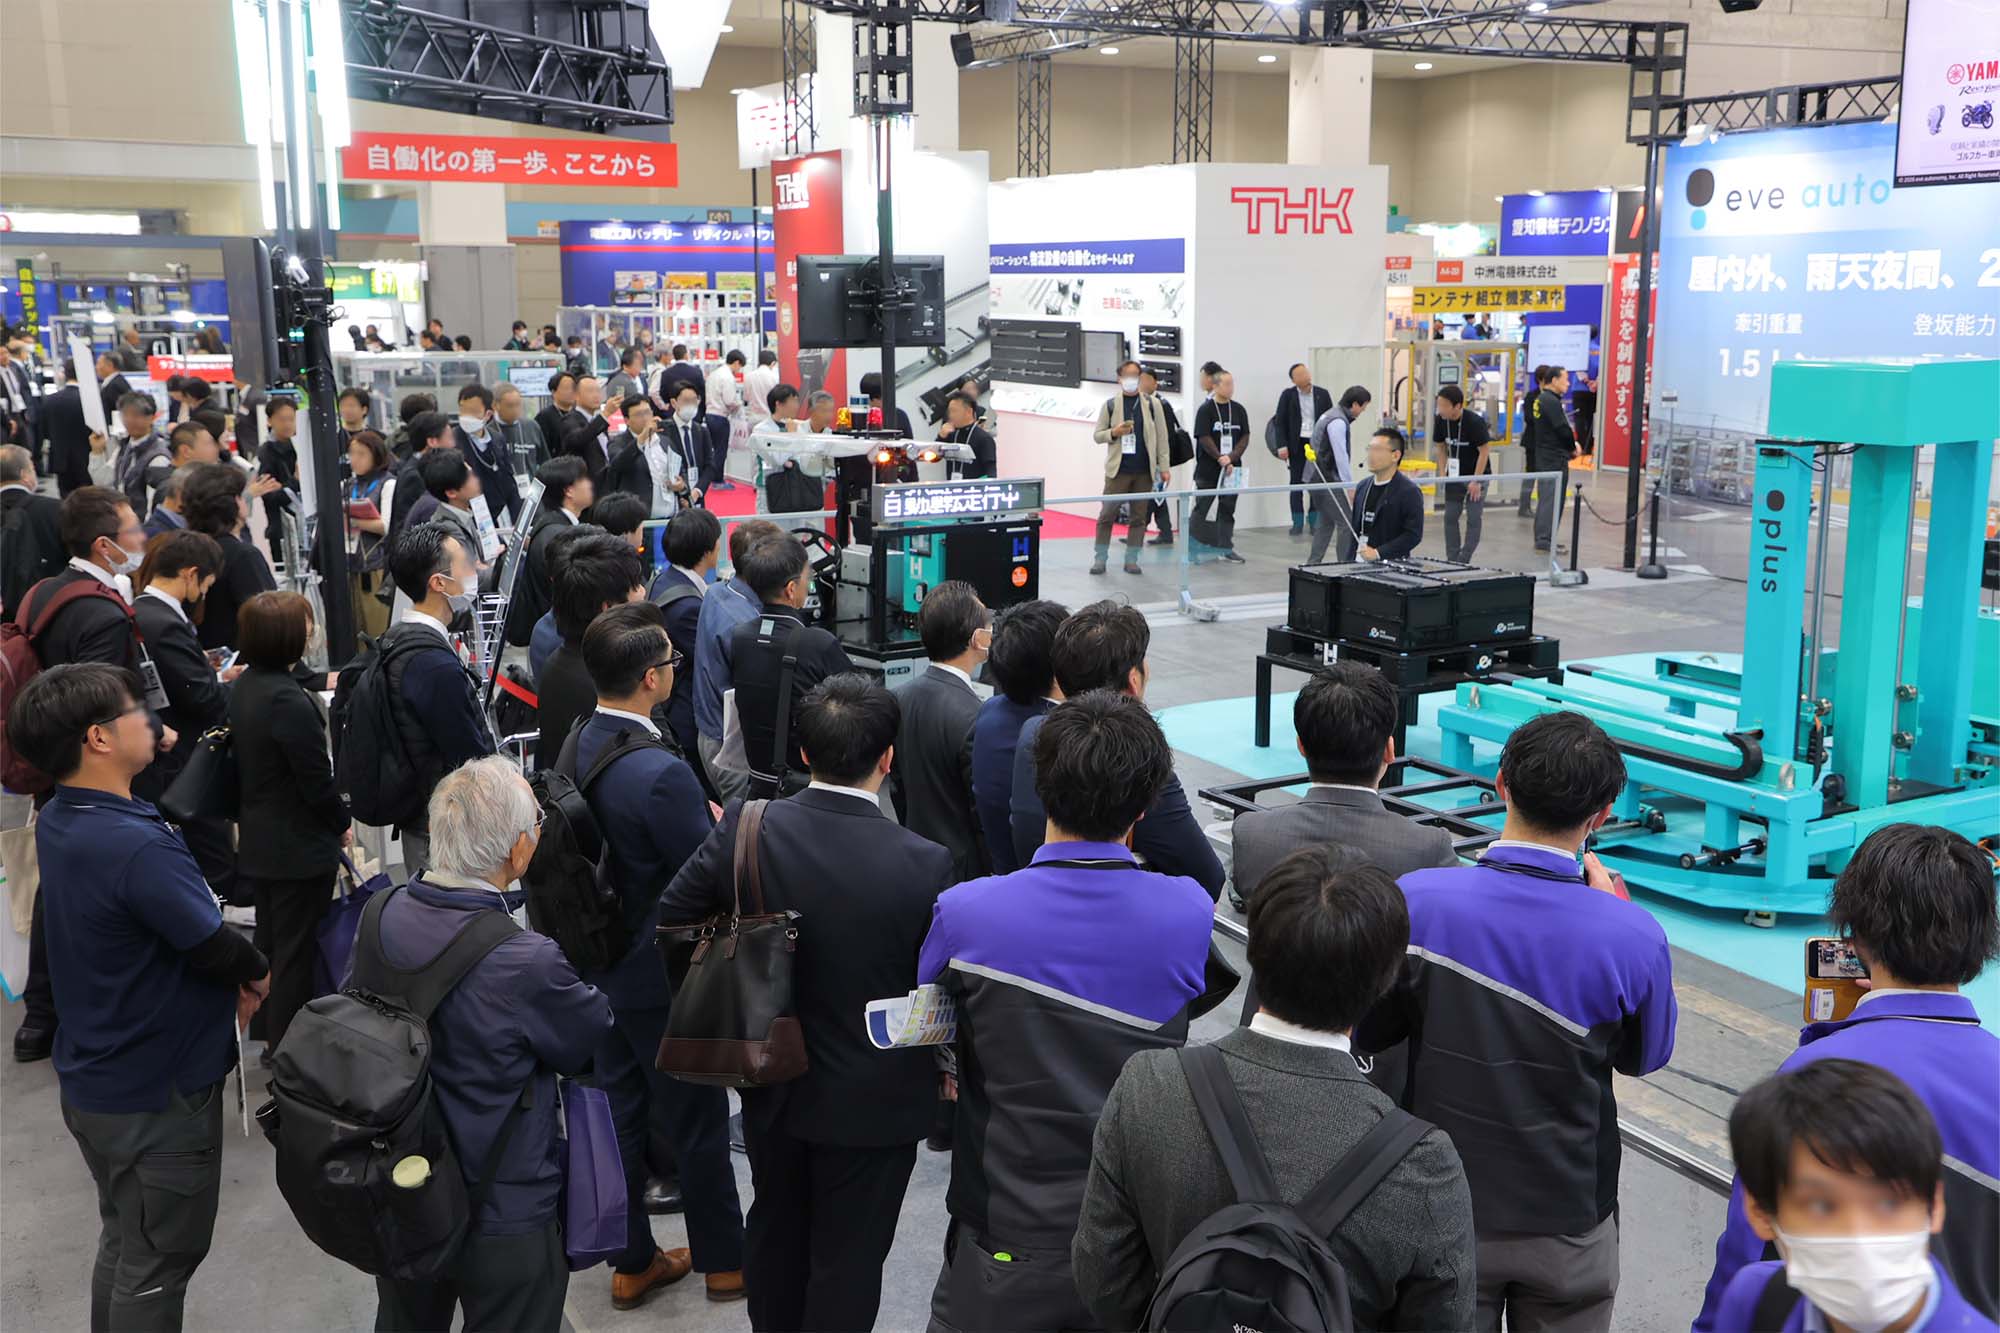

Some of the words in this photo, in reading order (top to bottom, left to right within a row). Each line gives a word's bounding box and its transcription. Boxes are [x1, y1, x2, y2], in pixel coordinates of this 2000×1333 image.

[1967, 60, 2000, 81] YAM
[367, 144, 656, 177] 自働化の第一歩、ここから
[1725, 188, 1785, 211] eve
[1801, 173, 1890, 208] auto
[1231, 187, 1354, 234] THK
[1414, 289, 1562, 307] コンテナ組立機実演中
[1735, 312, 1803, 335] 牽引重量
[1913, 313, 1996, 336] 登坂能力
[1719, 348, 1761, 377] 1.5
[1759, 518, 1788, 593] plus
